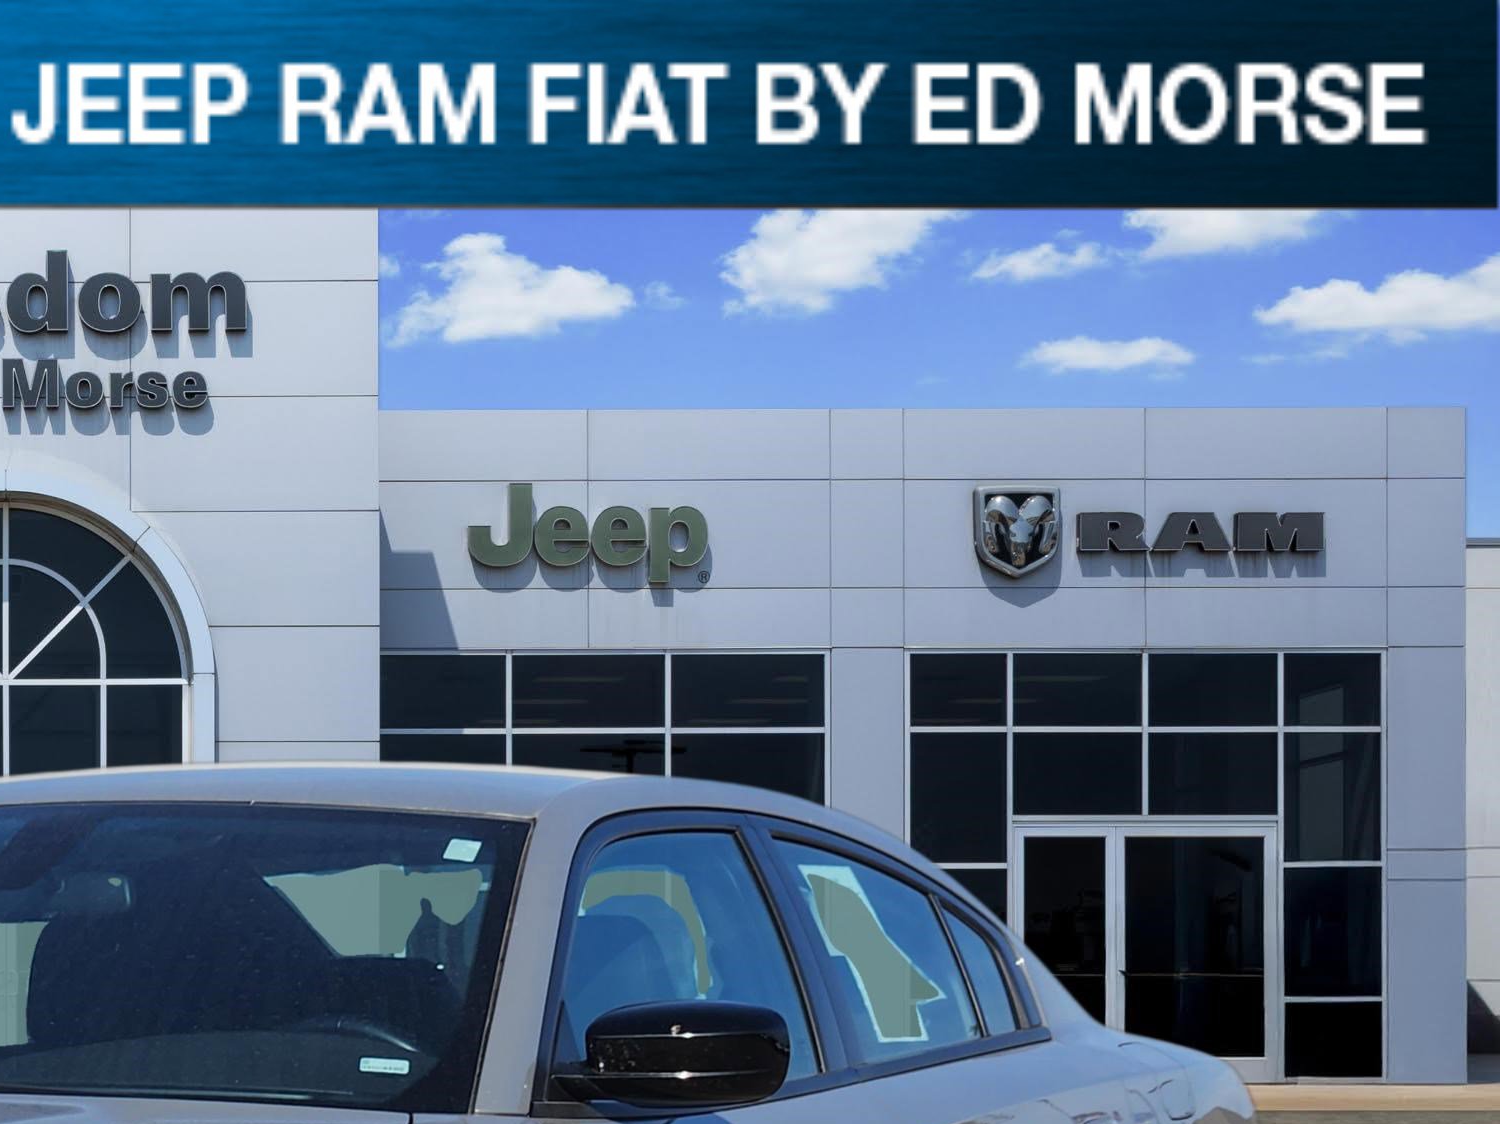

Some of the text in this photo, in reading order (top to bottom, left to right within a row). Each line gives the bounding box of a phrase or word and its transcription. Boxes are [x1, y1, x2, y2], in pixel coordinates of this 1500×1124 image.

[1, 358, 209, 409] Morse
[467, 482, 709, 584] Jeep
[1076, 512, 1326, 551] RAM
